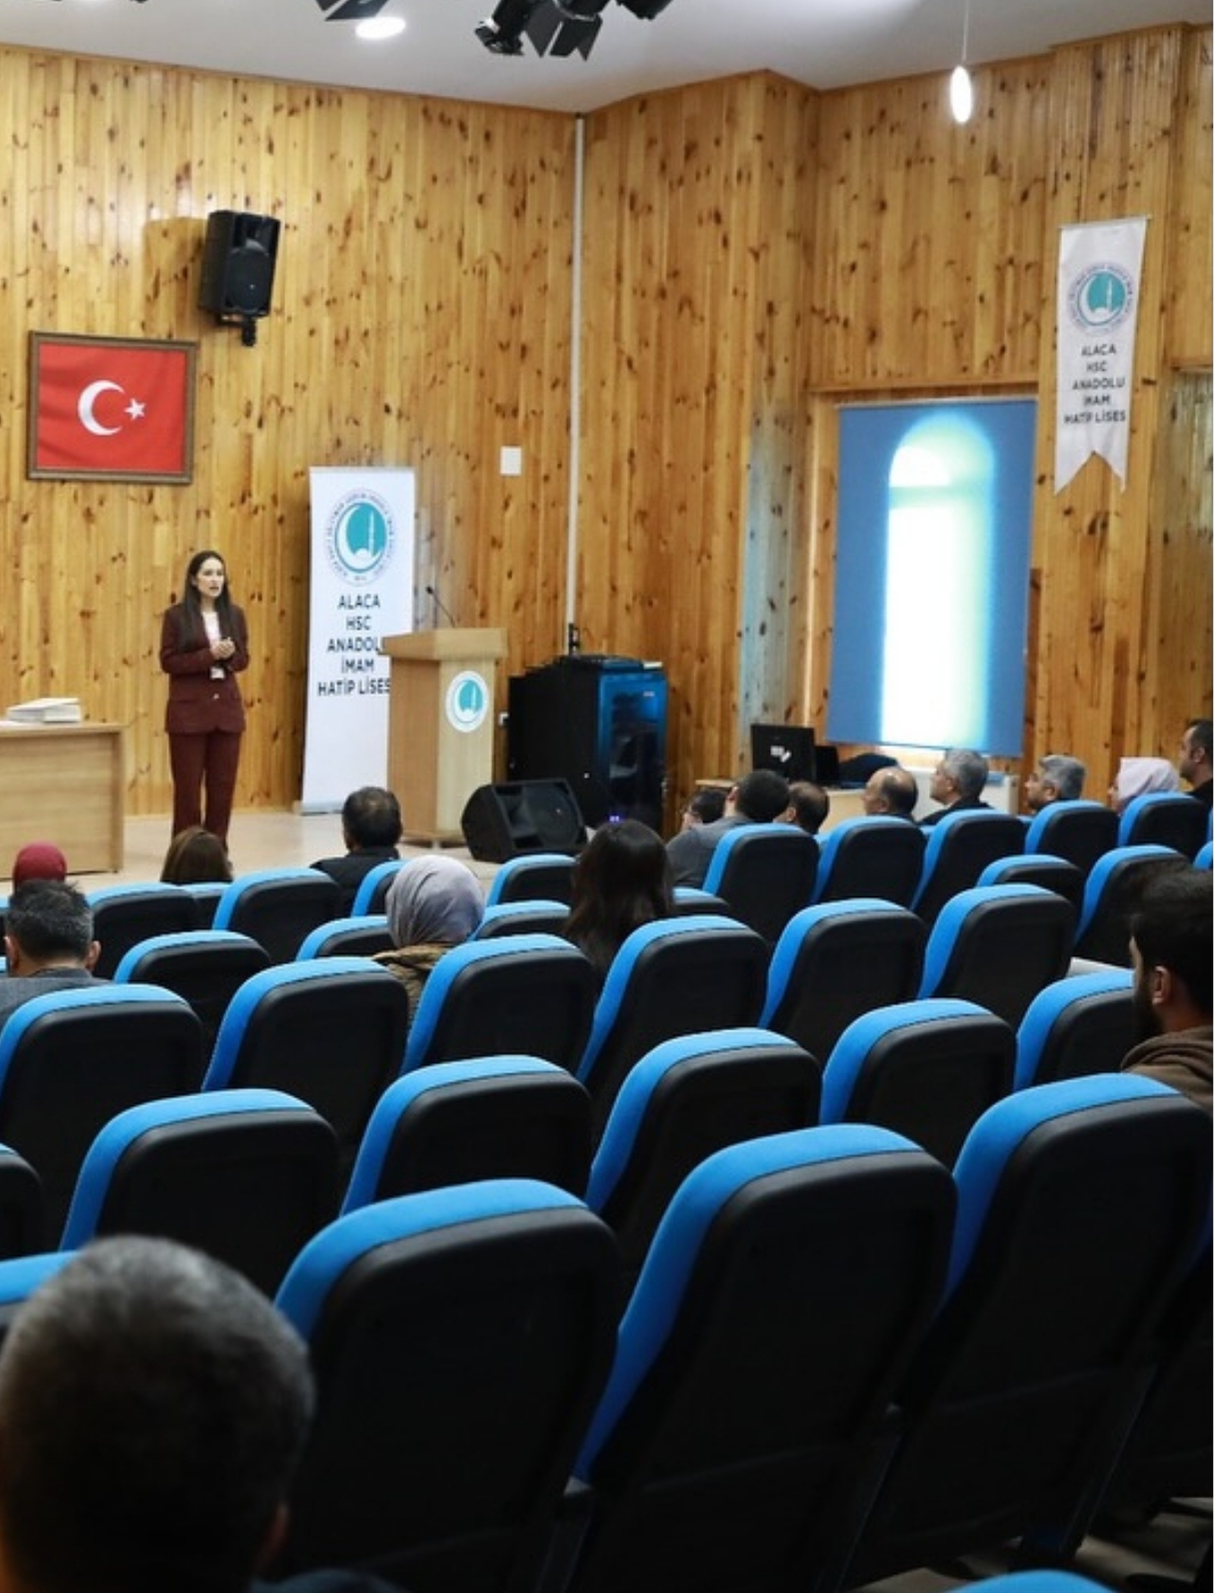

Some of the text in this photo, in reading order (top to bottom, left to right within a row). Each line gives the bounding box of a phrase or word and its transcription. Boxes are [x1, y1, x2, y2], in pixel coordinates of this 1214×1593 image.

[337, 593, 381, 610] ALACA
[346, 615, 372, 631] HSC
[326, 637, 379, 653] ANADOL
[317, 678, 356, 696] HATİP
